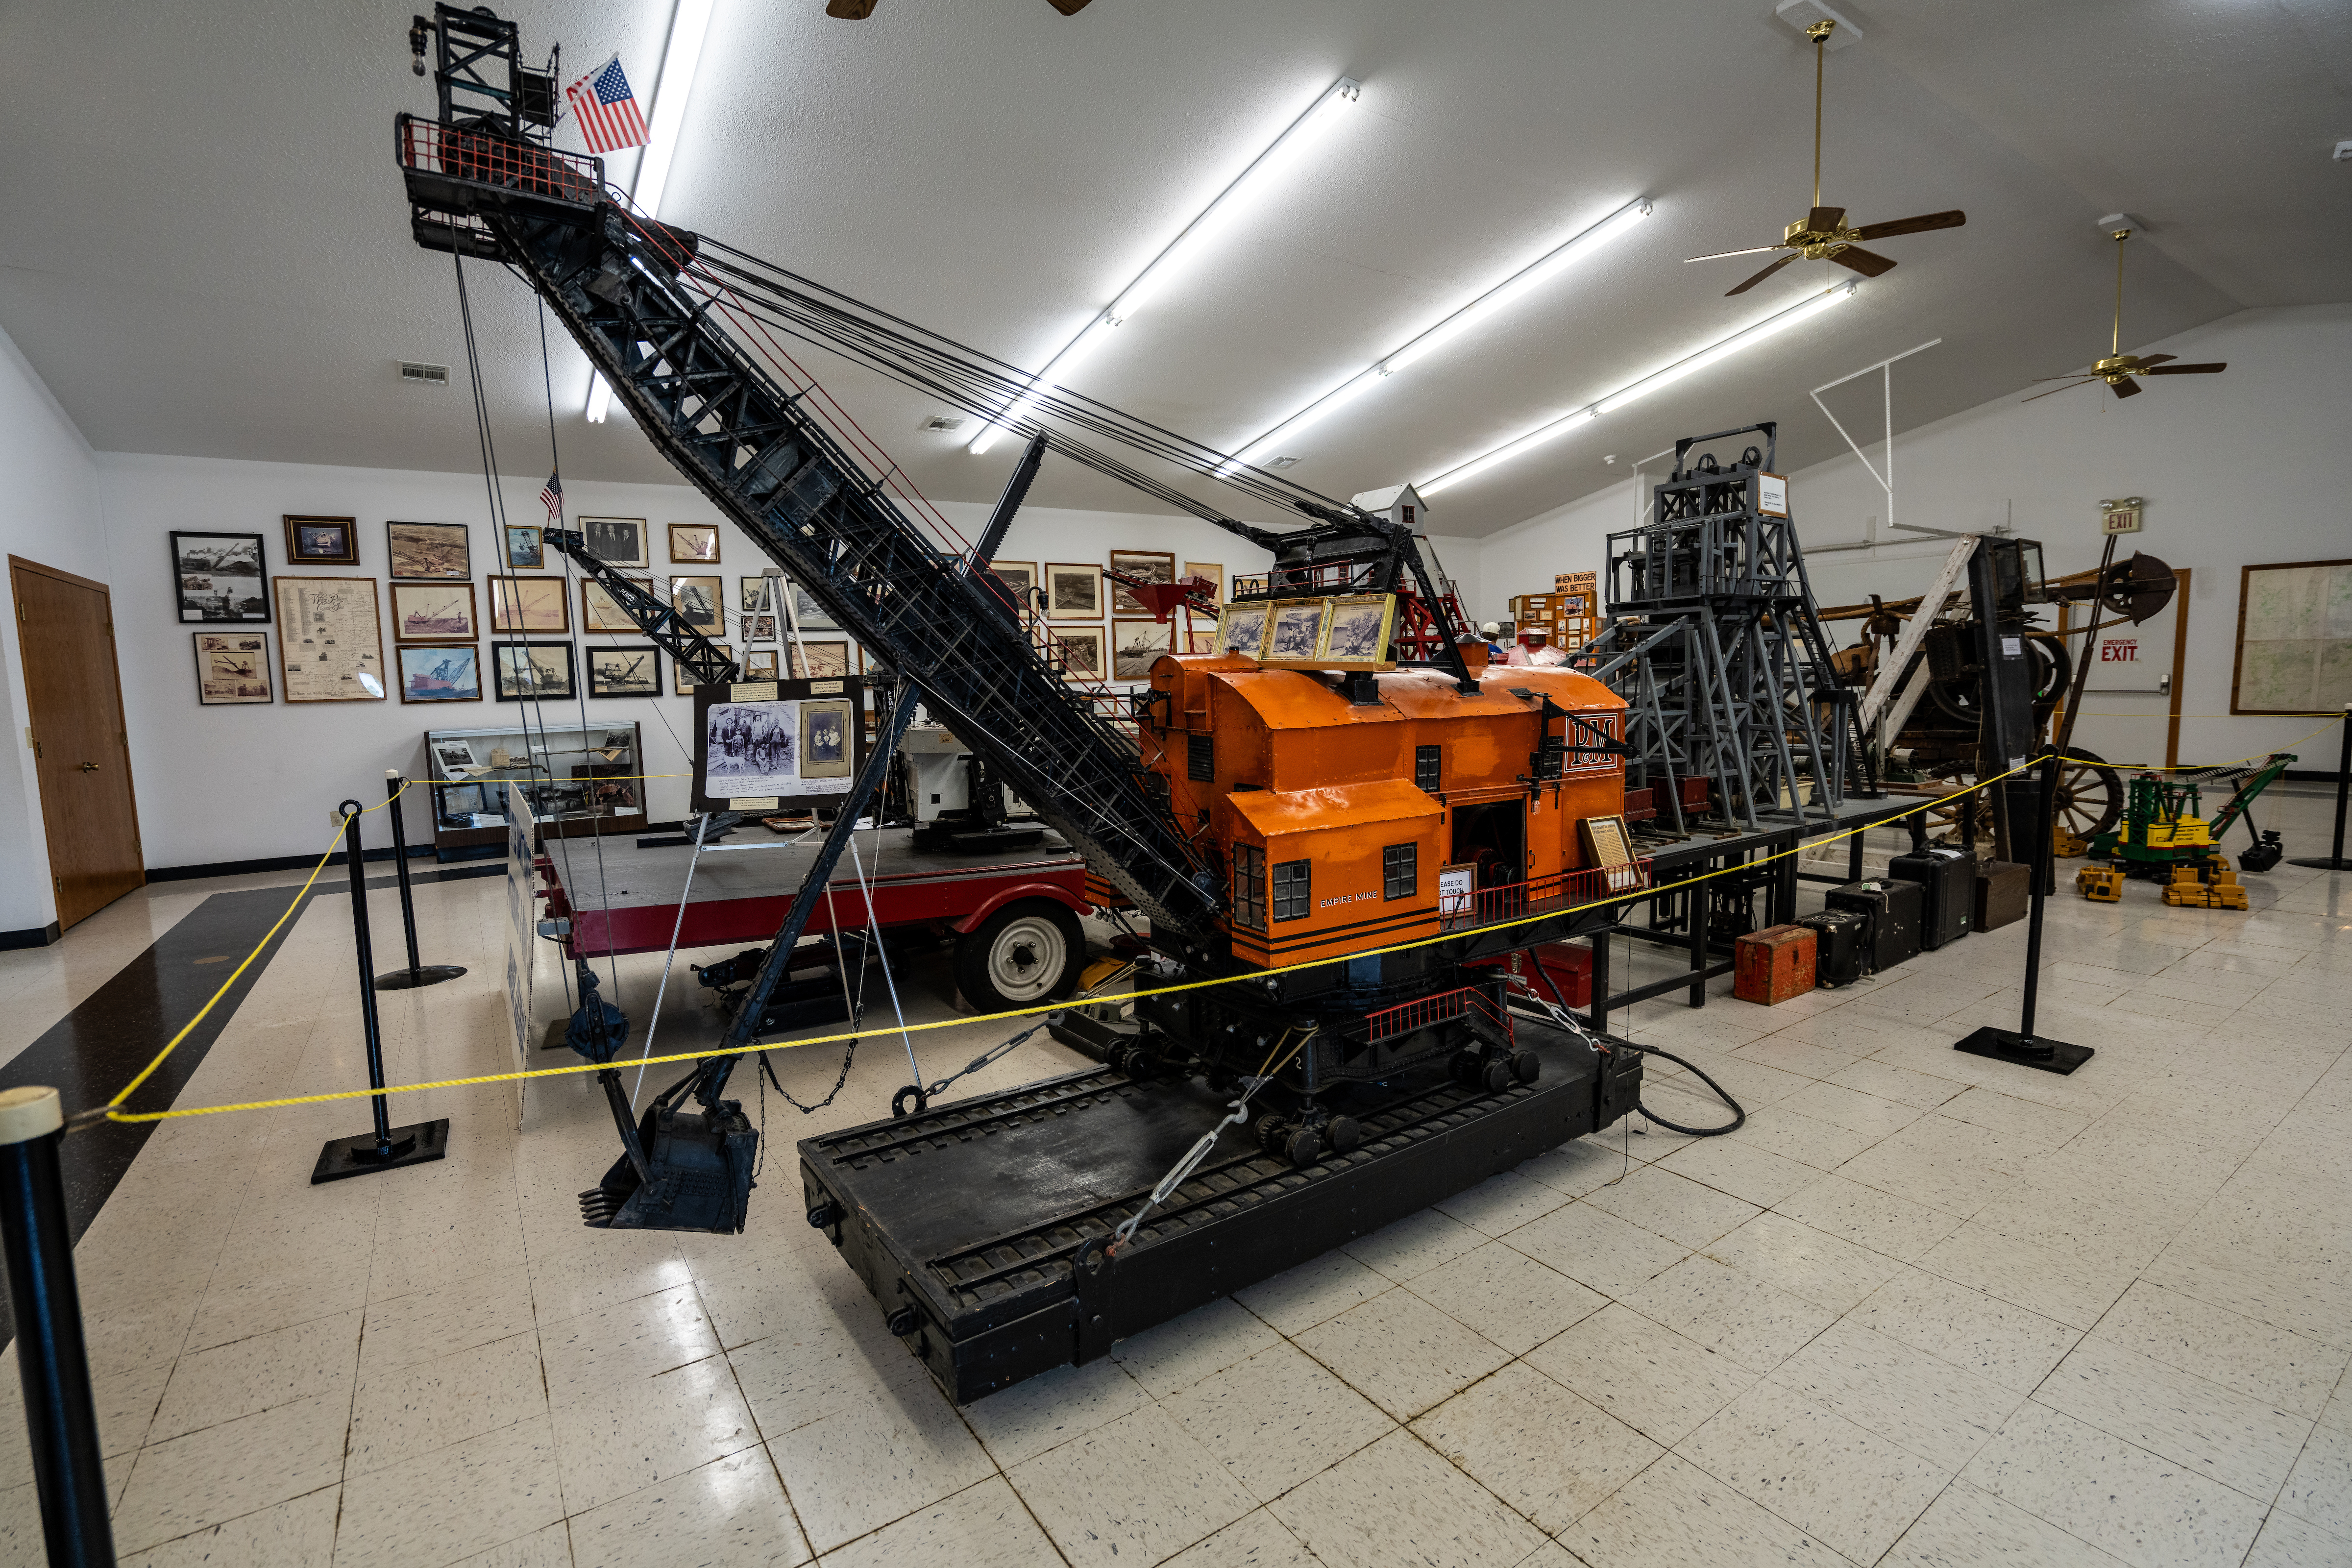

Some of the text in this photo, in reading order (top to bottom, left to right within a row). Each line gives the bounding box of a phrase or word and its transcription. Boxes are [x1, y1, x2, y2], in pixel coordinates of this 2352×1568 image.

[2109, 513, 2133, 529] EXIT
[1556, 573, 1595, 584] WHEN BIGGER
[1570, 582, 1594, 591] BETTER
[620, 589, 634, 601] PEMCO
[2102, 646, 2138, 661] EXIT
[1571, 719, 1613, 766] P&M
[1320, 890, 1377, 908] EMPIRE MINE
[1296, 1057, 1302, 1069] 2
